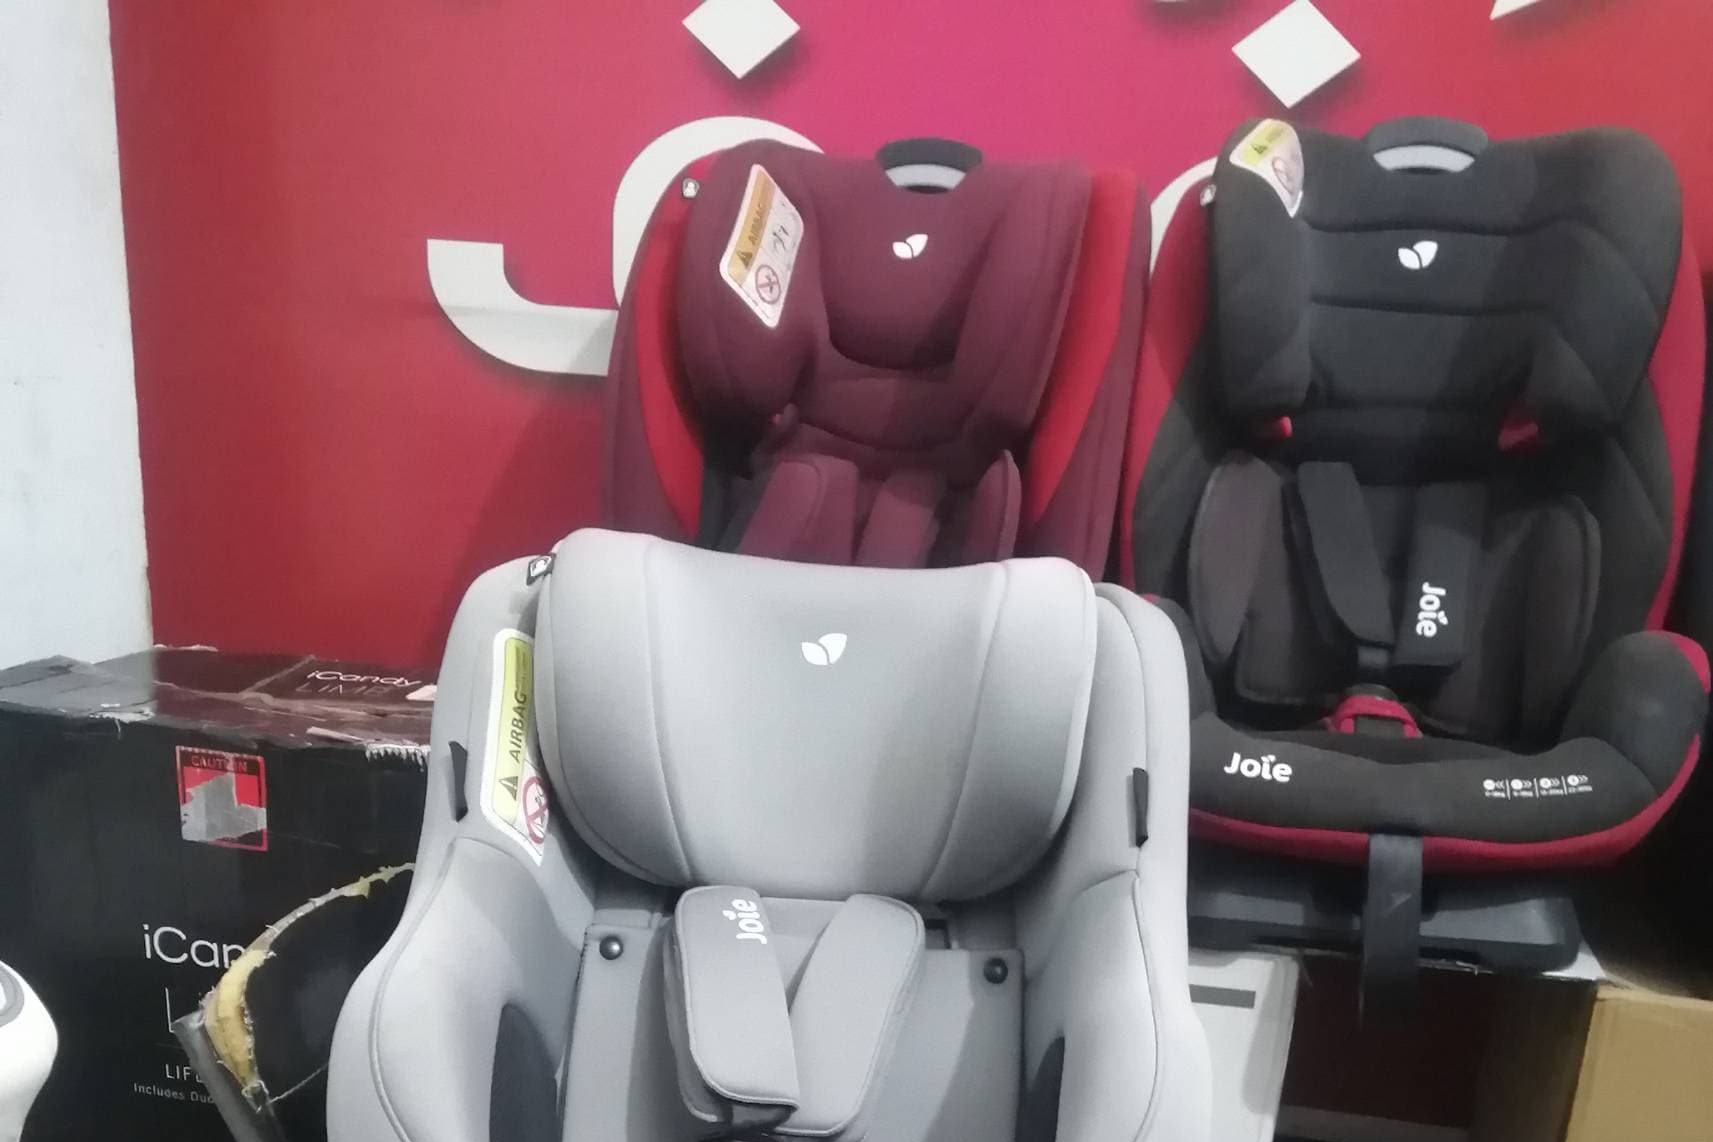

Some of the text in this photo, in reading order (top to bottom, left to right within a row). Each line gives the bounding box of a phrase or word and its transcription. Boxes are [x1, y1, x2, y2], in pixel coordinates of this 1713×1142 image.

[1415, 581, 1449, 638] Joie
[306, 670, 422, 687] iCandy
[508, 690, 530, 764] AIRBAG
[1223, 751, 1293, 783] Joie
[722, 898, 768, 945] Joie
[133, 1082, 185, 1101] Includes
